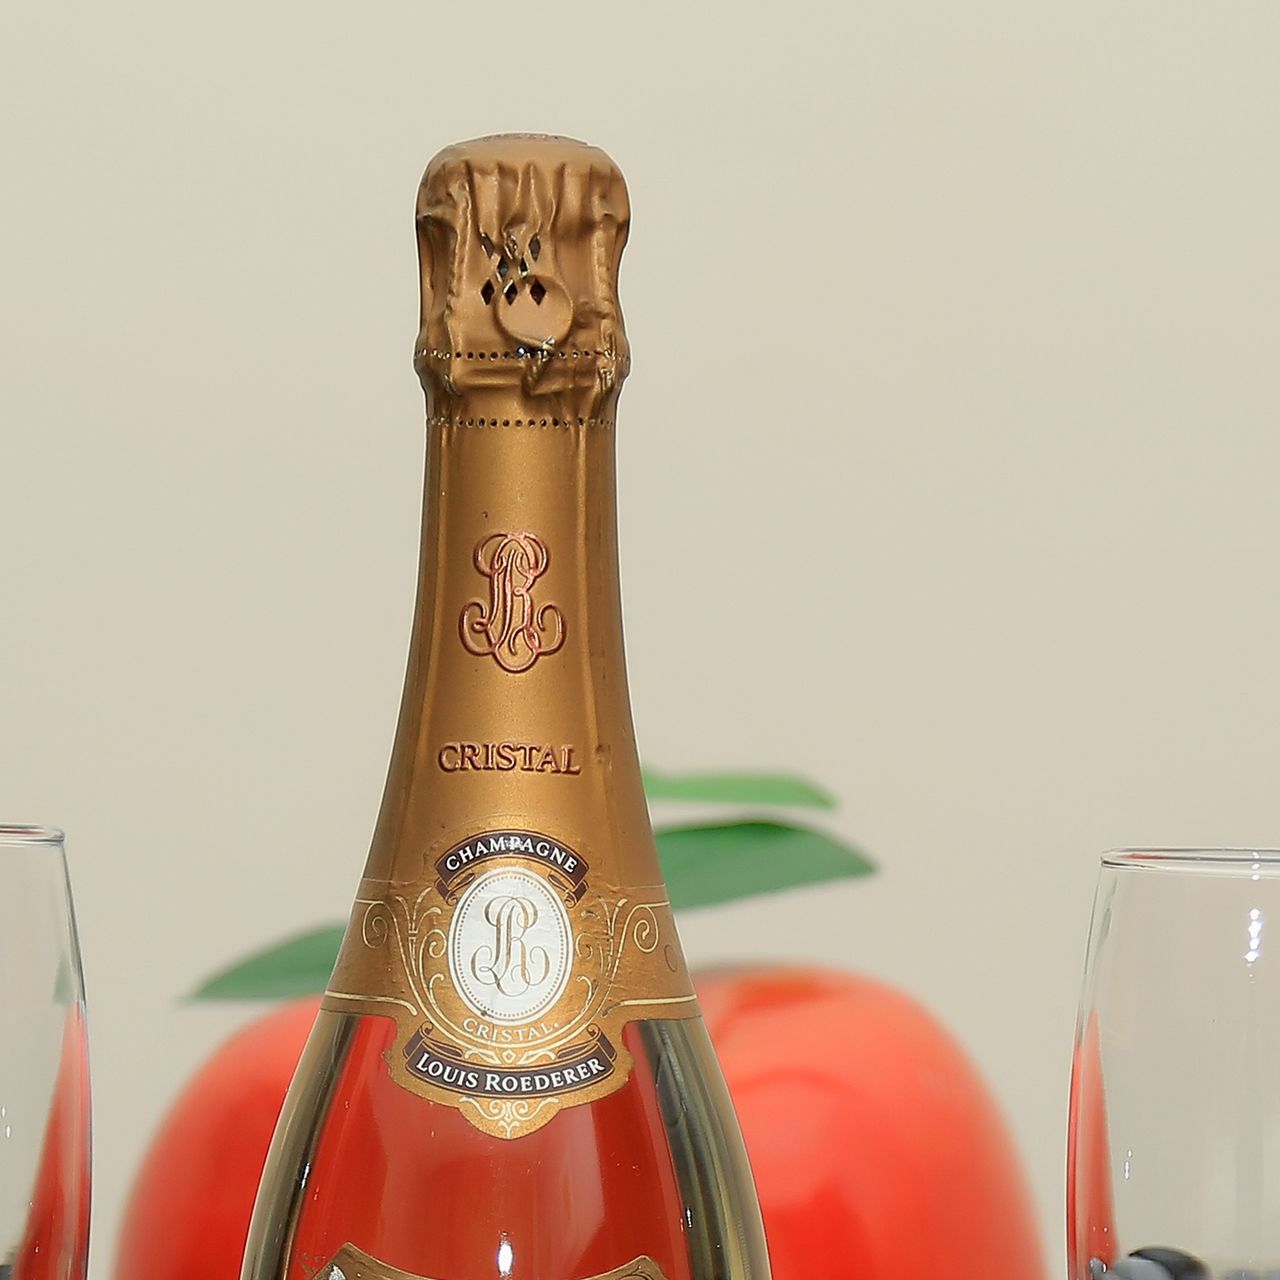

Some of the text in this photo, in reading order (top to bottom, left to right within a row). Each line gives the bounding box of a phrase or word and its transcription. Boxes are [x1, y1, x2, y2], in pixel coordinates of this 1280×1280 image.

[438, 742, 582, 776] CRISTAL
[445, 836, 578, 873] CHAMPAGNE
[414, 1052, 606, 1092] LOUIS ROEDERER
